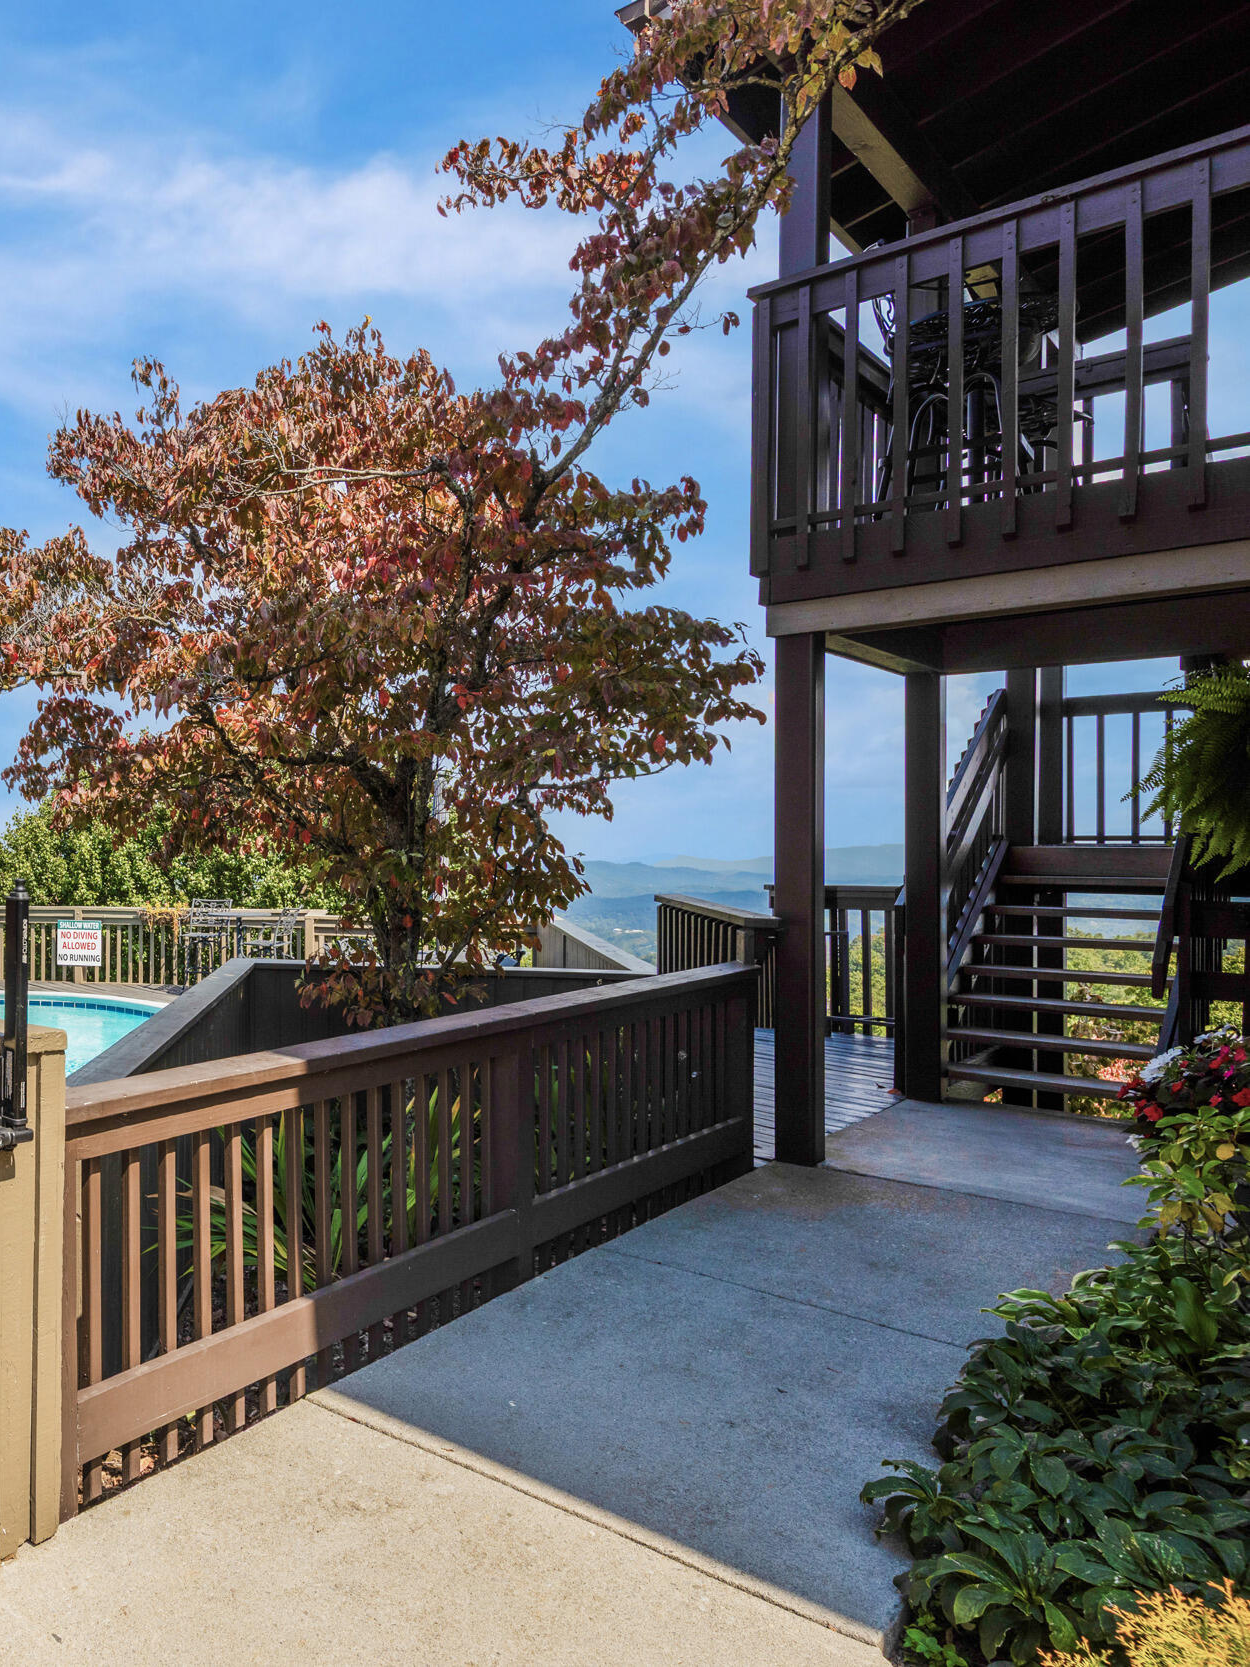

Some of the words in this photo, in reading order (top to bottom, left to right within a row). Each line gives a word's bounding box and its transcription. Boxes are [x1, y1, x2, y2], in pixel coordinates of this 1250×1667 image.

[60, 921, 82, 929] SHALLOW
[61, 931, 72, 939] NO
[73, 931, 98, 940] DIVING
[62, 942, 96, 950] ALLOWED
[70, 954, 100, 962] RUNNING
